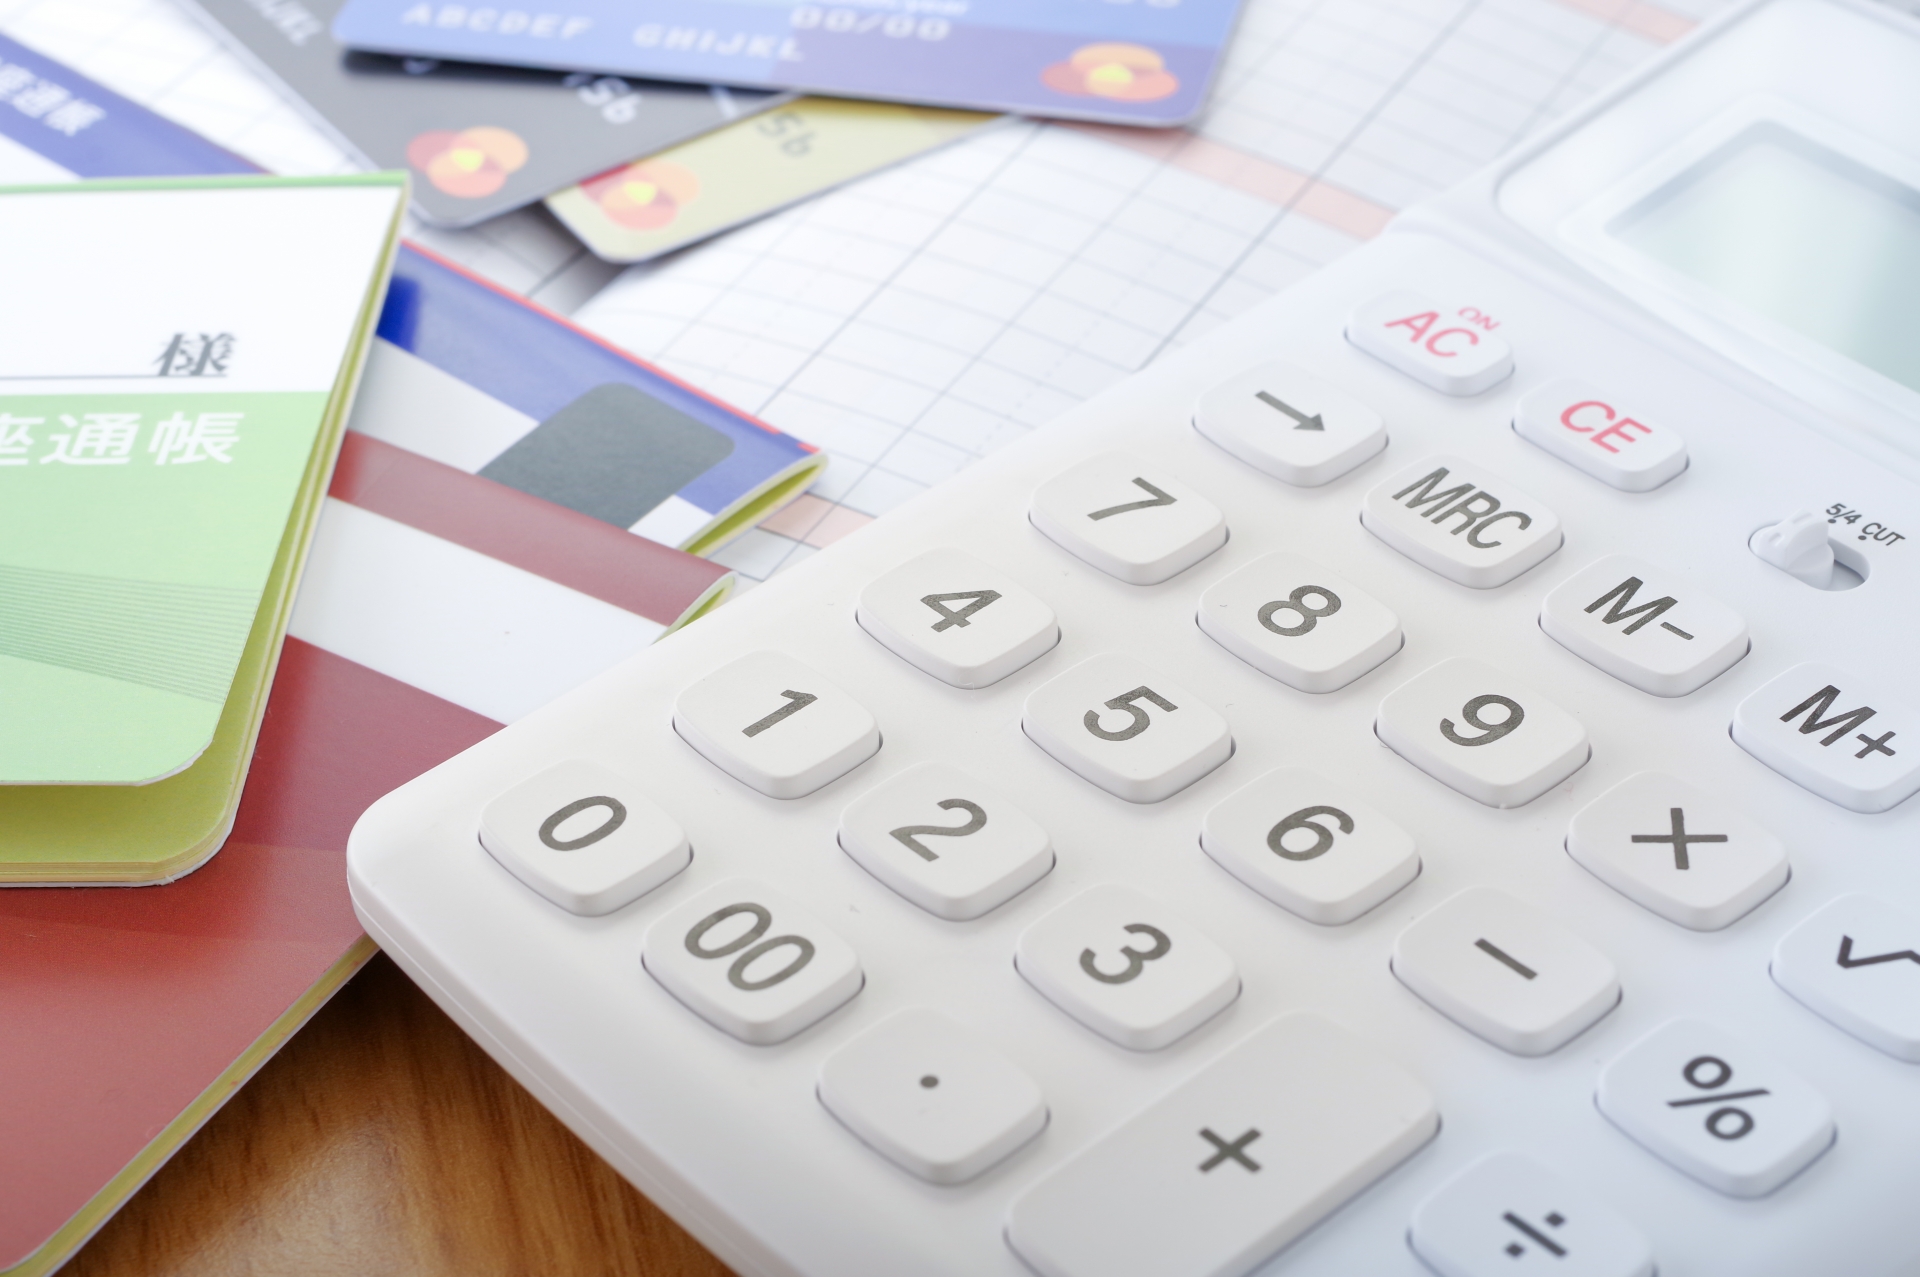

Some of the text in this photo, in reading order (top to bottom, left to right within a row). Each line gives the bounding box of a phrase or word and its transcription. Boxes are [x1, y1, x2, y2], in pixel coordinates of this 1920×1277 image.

[401, 3, 805, 62] ABCDEF GHIJKL
[1384, 310, 1479, 357] AC
[1458, 307, 1500, 331] ON
[153, 332, 236, 377] 様
[1560, 401, 1652, 453] CE
[1087, 477, 1177, 521] 7
[1391, 467, 1533, 550] MRC
[1826, 502, 1906, 546] 5/4 CUT
[920, 590, 1002, 632] 4
[1258, 585, 1341, 636] 8
[1584, 576, 1694, 640] M-
[742, 690, 818, 738] 1
[1084, 686, 1178, 741] 5
[1440, 694, 1524, 746] 9
[1779, 685, 1896, 759] M+
[539, 796, 627, 851] 0
[889, 799, 987, 862] 2
[1267, 806, 1354, 861] 6
[684, 902, 815, 991] 00
[1079, 923, 1171, 985] 3
[1667, 1056, 1770, 1141] %
